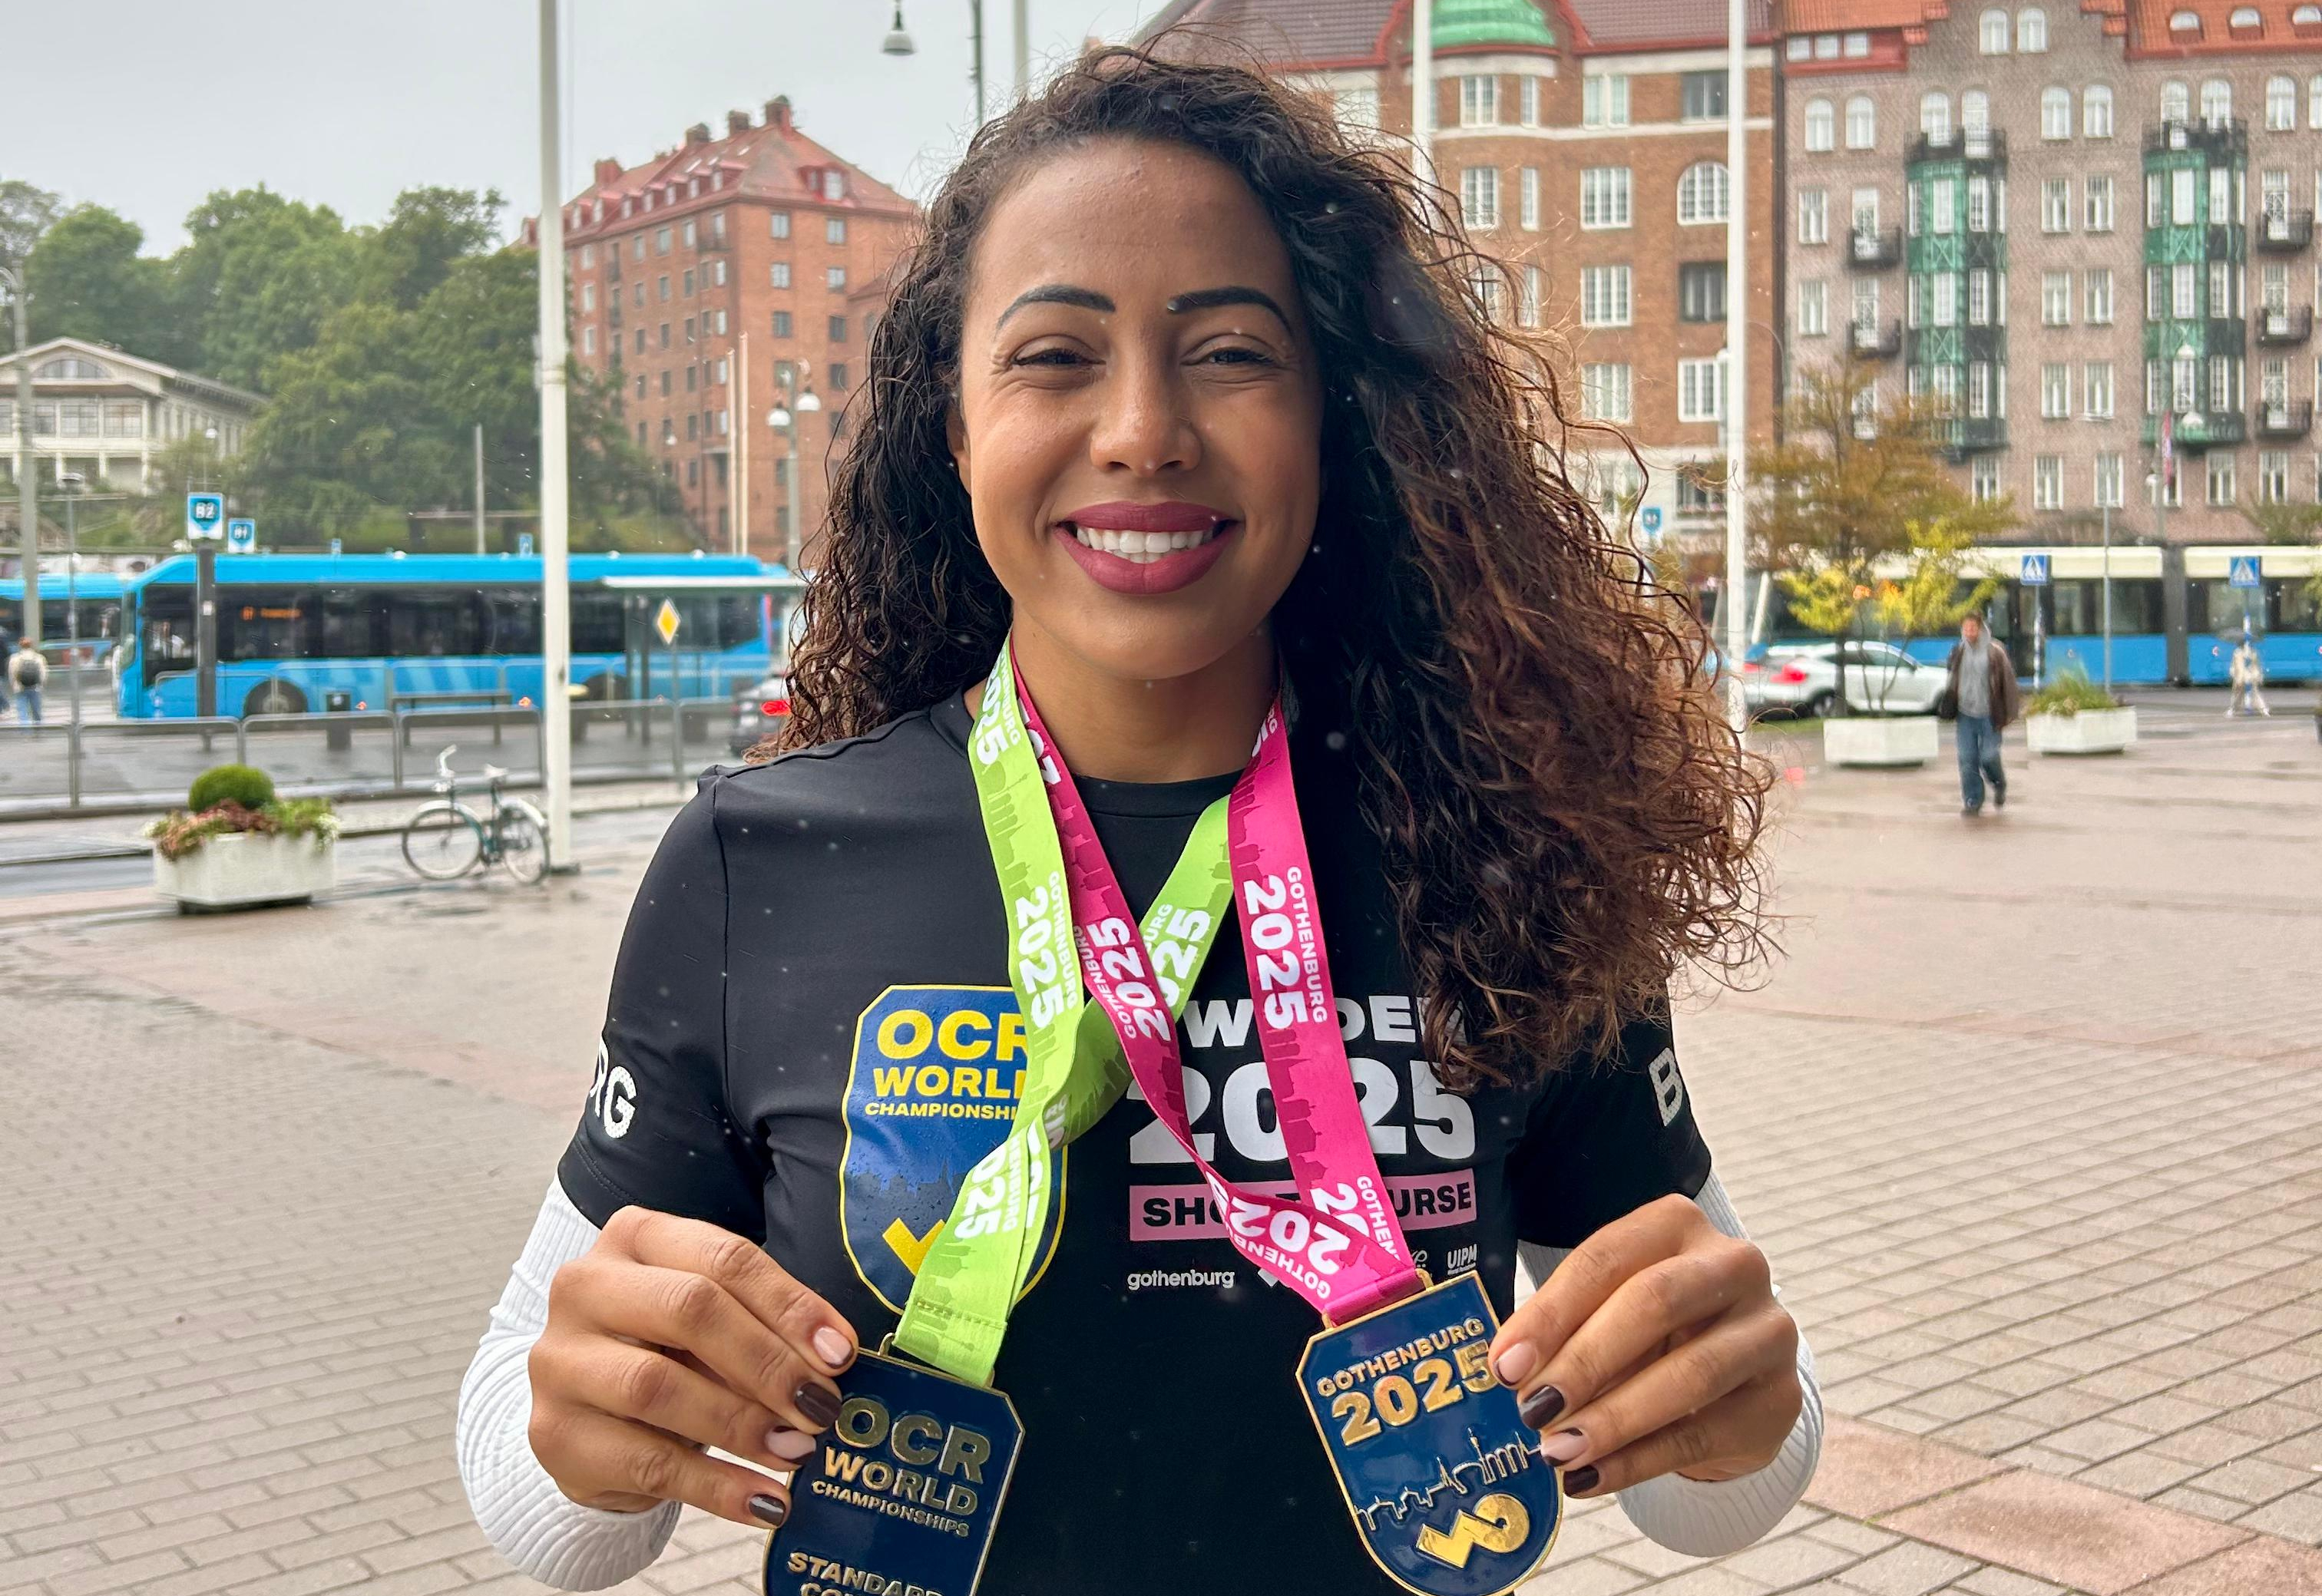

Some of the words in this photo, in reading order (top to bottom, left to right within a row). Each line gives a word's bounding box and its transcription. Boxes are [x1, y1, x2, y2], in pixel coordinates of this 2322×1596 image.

[1015, 886, 1064, 1029] 2025
[1048, 871, 1079, 1009] GOTHENBURG
[1073, 925, 1137, 1039] GOTHENBURG
[1087, 917, 1172, 1042] 2025
[1243, 874, 1308, 1029] 2025
[1286, 866, 1328, 1023] GOTHENBURG
[865, 1102, 1018, 1120] CHAMPIONSHI
[1126, 1057, 1475, 1165] 2025
[1648, 1047, 1683, 1127] B
[954, 1142, 1005, 1239] 025
[1387, 1182, 1471, 1218] URSE
[1127, 1269, 1235, 1290] gothenburg
[1447, 1244, 1477, 1269] UIPM
[1317, 1317, 1484, 1396] GOTHENBURG
[1331, 1339, 1498, 1446] 2025
[825, 1446, 977, 1516] WORLD
[835, 1397, 991, 1484] OCR
[812, 1480, 969, 1537] CHAMPIONSHIPS
